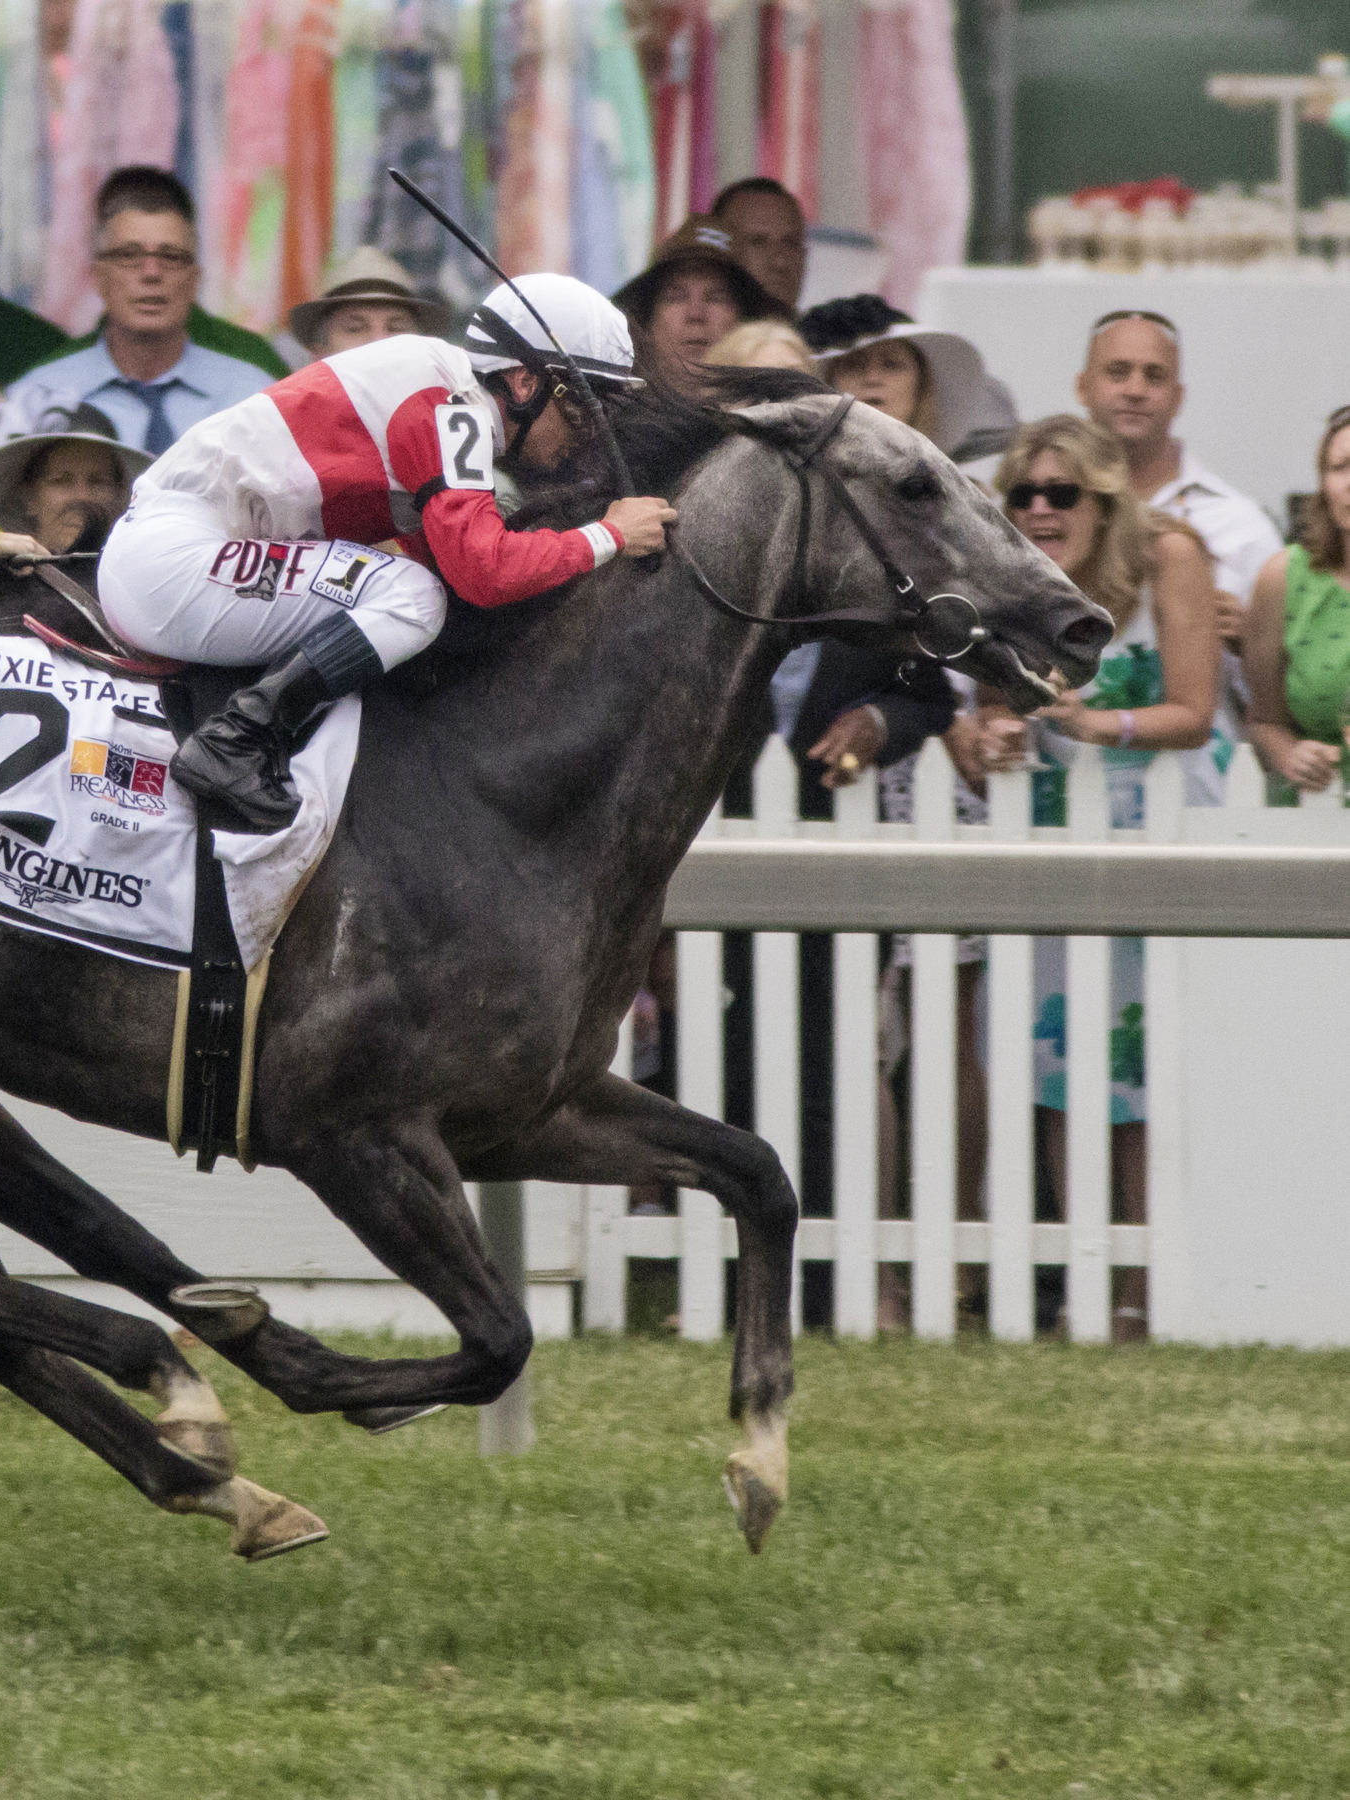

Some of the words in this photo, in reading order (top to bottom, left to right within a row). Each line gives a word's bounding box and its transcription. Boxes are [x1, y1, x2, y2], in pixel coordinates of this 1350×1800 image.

[447, 411, 484, 482] 2
[336, 548, 354, 559] 75
[340, 541, 387, 561] JOCKEYS
[315, 581, 354, 604] GUILD
[90, 811, 130, 830] GRADE
[132, 821, 140, 832] II
